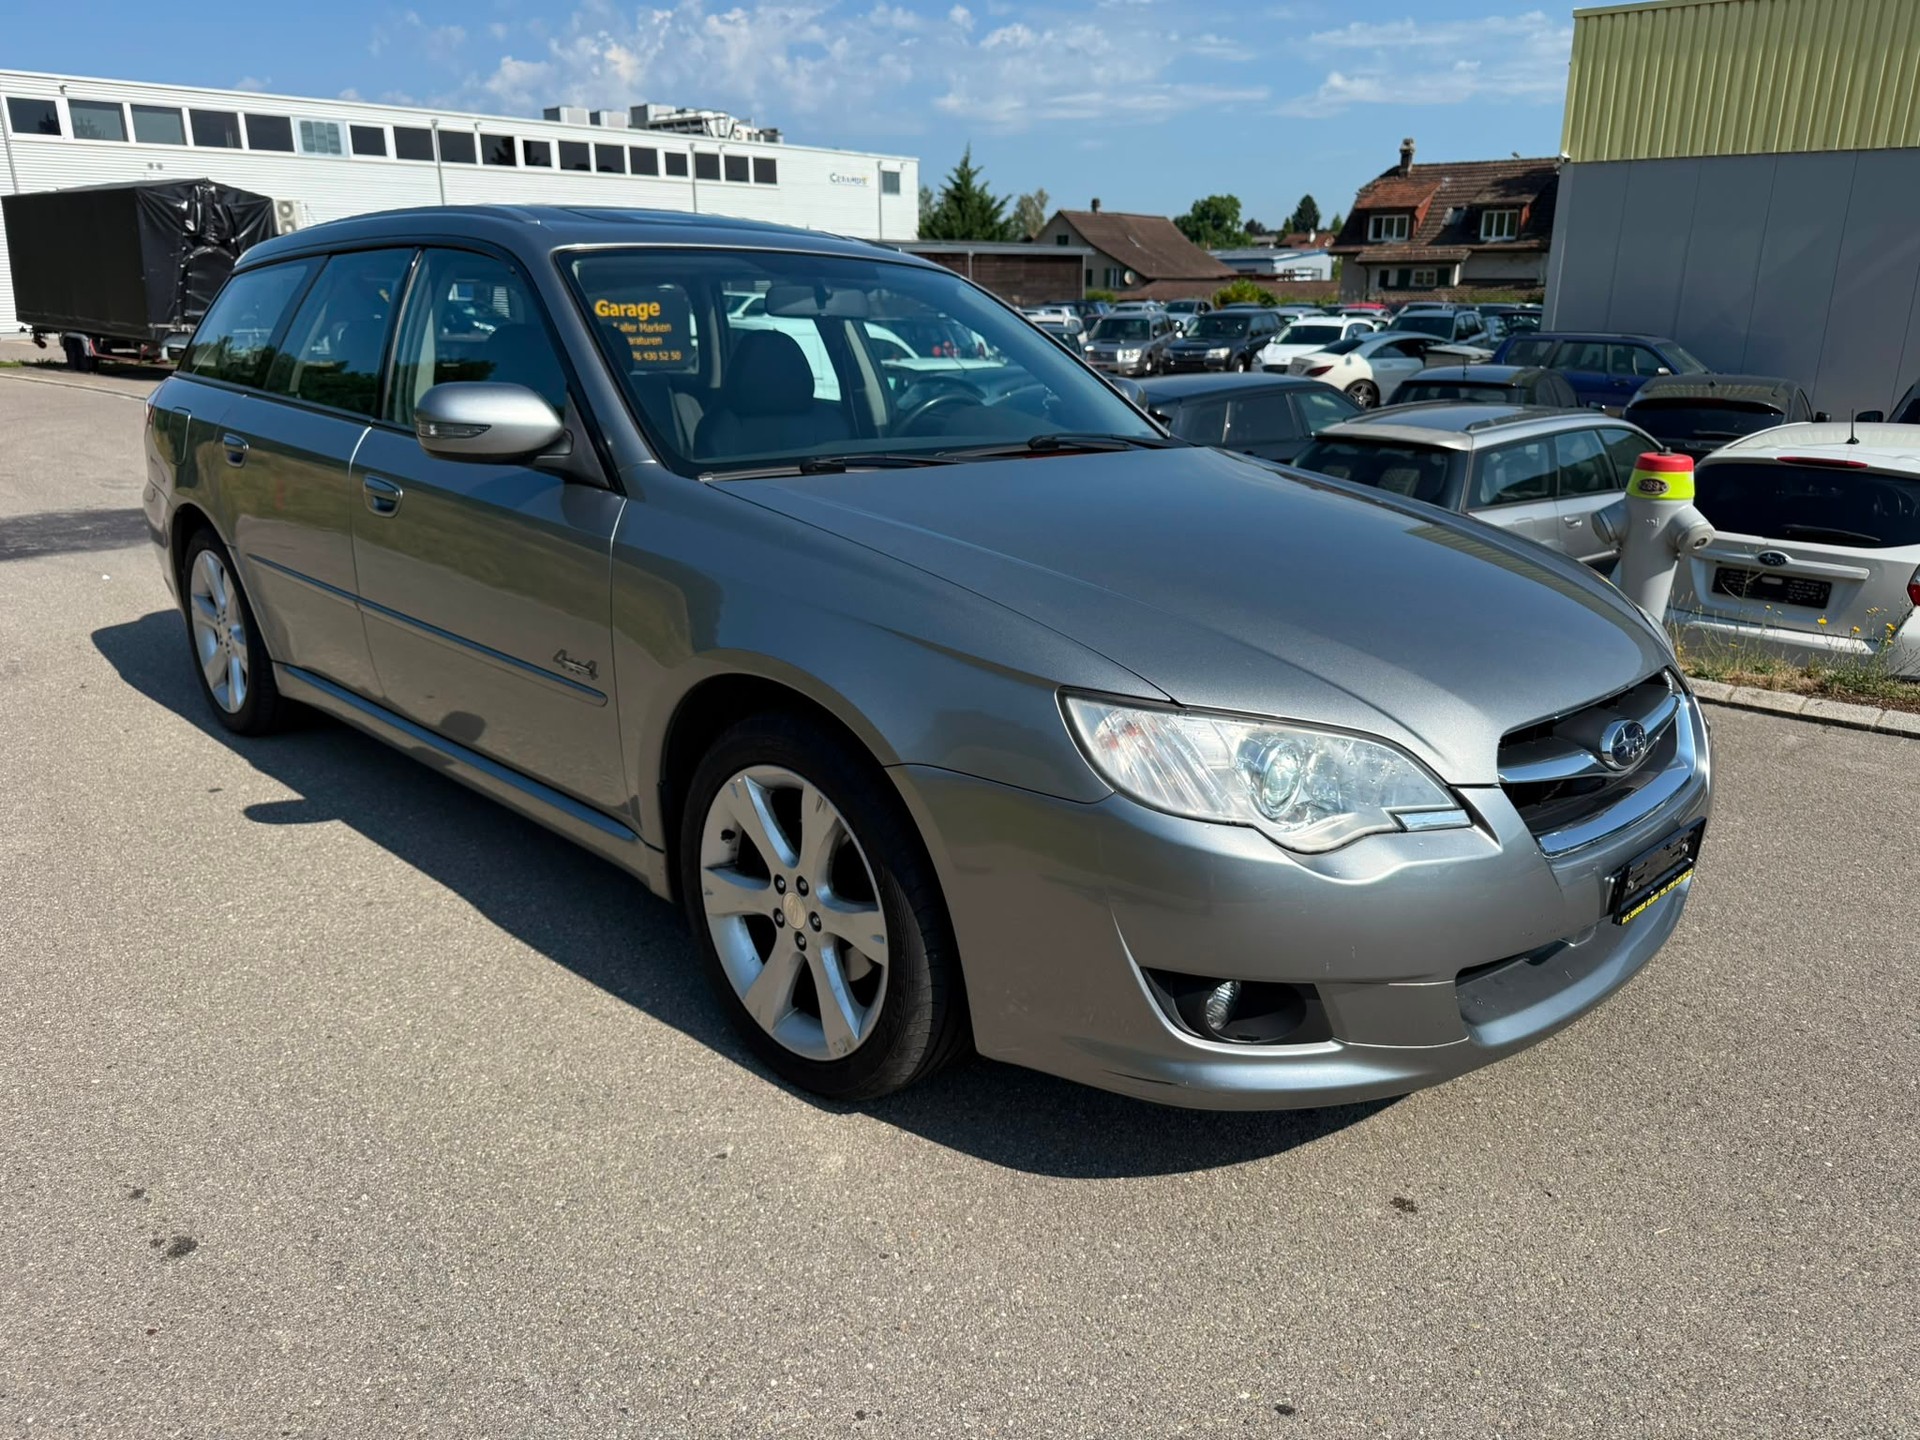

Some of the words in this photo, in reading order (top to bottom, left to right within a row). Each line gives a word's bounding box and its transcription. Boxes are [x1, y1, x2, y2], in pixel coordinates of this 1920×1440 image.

[594, 299, 661, 321] Garage
[638, 322, 672, 333] Marken
[658, 350, 669, 361] 52
